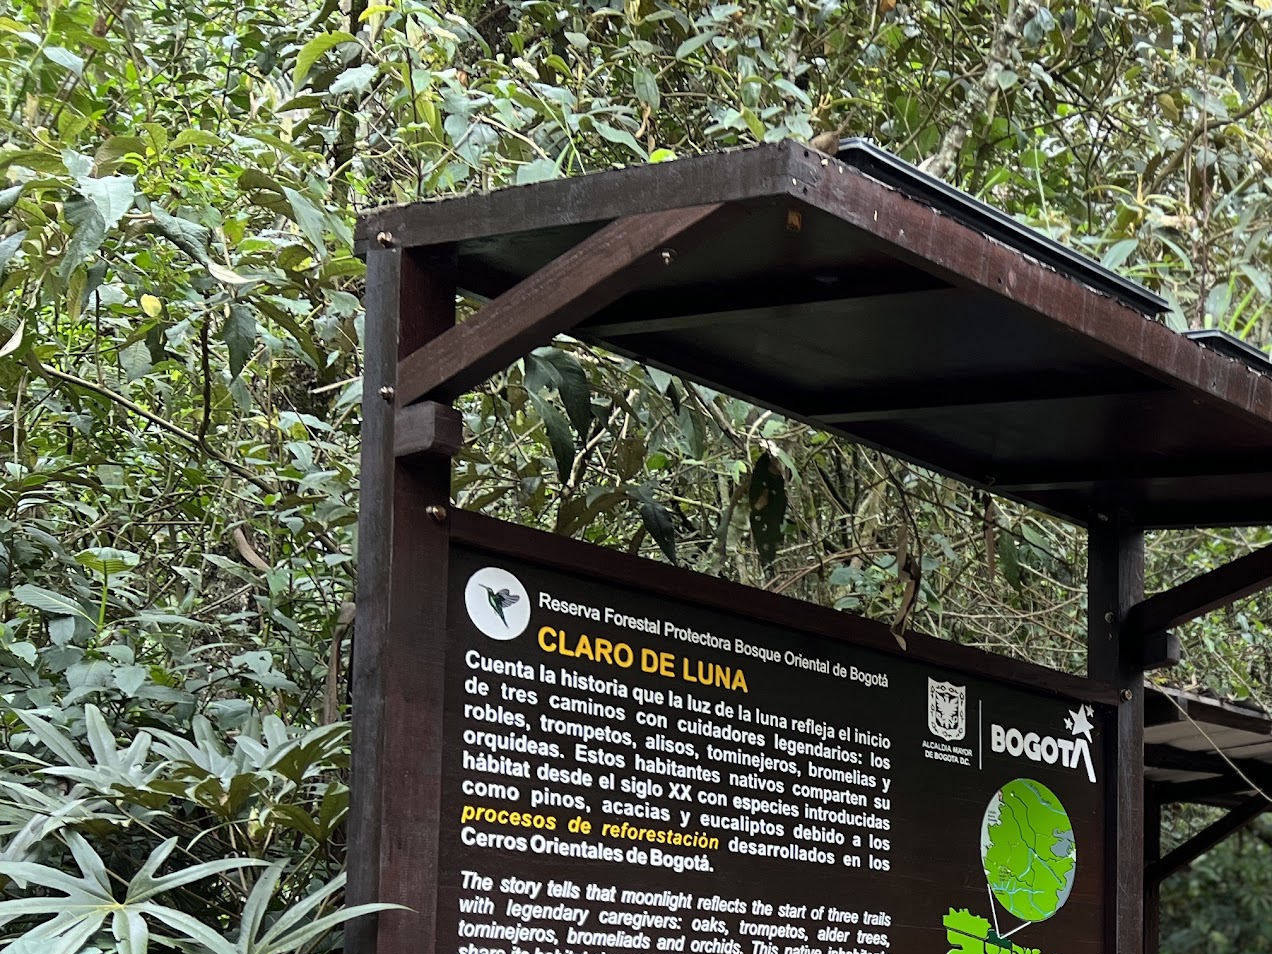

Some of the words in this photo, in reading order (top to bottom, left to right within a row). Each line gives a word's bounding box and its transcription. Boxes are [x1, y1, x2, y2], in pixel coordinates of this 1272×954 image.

[537, 626, 634, 668] CLARO
[641, 647, 676, 678] DE
[683, 657, 749, 694] LUNA
[538, 591, 601, 622] Reserva
[604, 606, 661, 636] Forestal
[664, 621, 732, 652] Protectora
[734, 638, 782, 663] Bosque
[784, 650, 830, 675] Oriental
[832, 662, 848, 678] de
[849, 665, 889, 688] Bogotá
[464, 675, 490, 697] de
[500, 682, 538, 705] tres
[548, 695, 626, 721] caminos
[635, 711, 668, 729] con
[677, 718, 766, 747] cuidadores
[774, 733, 863, 765] legendarios:
[870, 751, 891, 770] los
[465, 649, 535, 681] Cuenta
[539, 663, 557, 685] la
[560, 668, 628, 699] historia
[632, 686, 665, 706] que
[668, 689, 683, 709] la
[687, 693, 712, 715] luz
[714, 700, 735, 719] de
[738, 704, 752, 723] la
[755, 707, 788, 730] luna
[791, 718, 835, 740] refleja
[838, 726, 851, 742] el
[854, 727, 891, 750] inicio
[464, 703, 531, 732] robles,
[539, 714, 637, 750] trompetos,
[645, 733, 700, 760] alisos,
[706, 744, 802, 778] tominejeros,
[808, 760, 877, 788] bromelias
[881, 777, 891, 793] y
[575, 743, 626, 769] Estos
[634, 753, 721, 784] habitantes
[729, 772, 785, 794] nativos
[791, 783, 868, 807] comparten
[873, 796, 891, 811] su
[462, 749, 531, 779] hábitat
[536, 762, 593, 788] desde
[598, 772, 615, 791] el
[620, 775, 664, 800] siglo
[668, 781, 693, 802] XX
[697, 790, 728, 807] con
[732, 795, 800, 818] especies
[804, 802, 891, 831] introducidas
[462, 779, 520, 801] como
[531, 786, 591, 814] pinos,
[601, 799, 671, 822] acacias
[679, 810, 691, 828] y
[699, 813, 785, 837] eucaliptos
[792, 823, 845, 845] debido
[852, 834, 861, 848] a
[868, 833, 891, 851] los
[460, 805, 557, 831] procesos
[567, 815, 592, 835] de
[601, 821, 719, 850] reforestación
[728, 836, 836, 865] desarrollados
[842, 854, 861, 868] en
[868, 853, 891, 872] los
[460, 826, 528, 852] Cerros
[529, 834, 624, 863] Orientales
[625, 846, 648, 865] de
[649, 848, 714, 873] Bogotá.
[460, 870, 494, 892] The
[499, 876, 543, 900] story
[546, 879, 582, 900] tells
[585, 883, 617, 903] that
[620, 890, 693, 912] moonlight
[696, 895, 748, 914] reflects
[751, 899, 773, 917] the
[777, 903, 808, 920] start
[810, 905, 826, 921] of
[827, 907, 859, 924] three
[862, 910, 892, 927] trails
